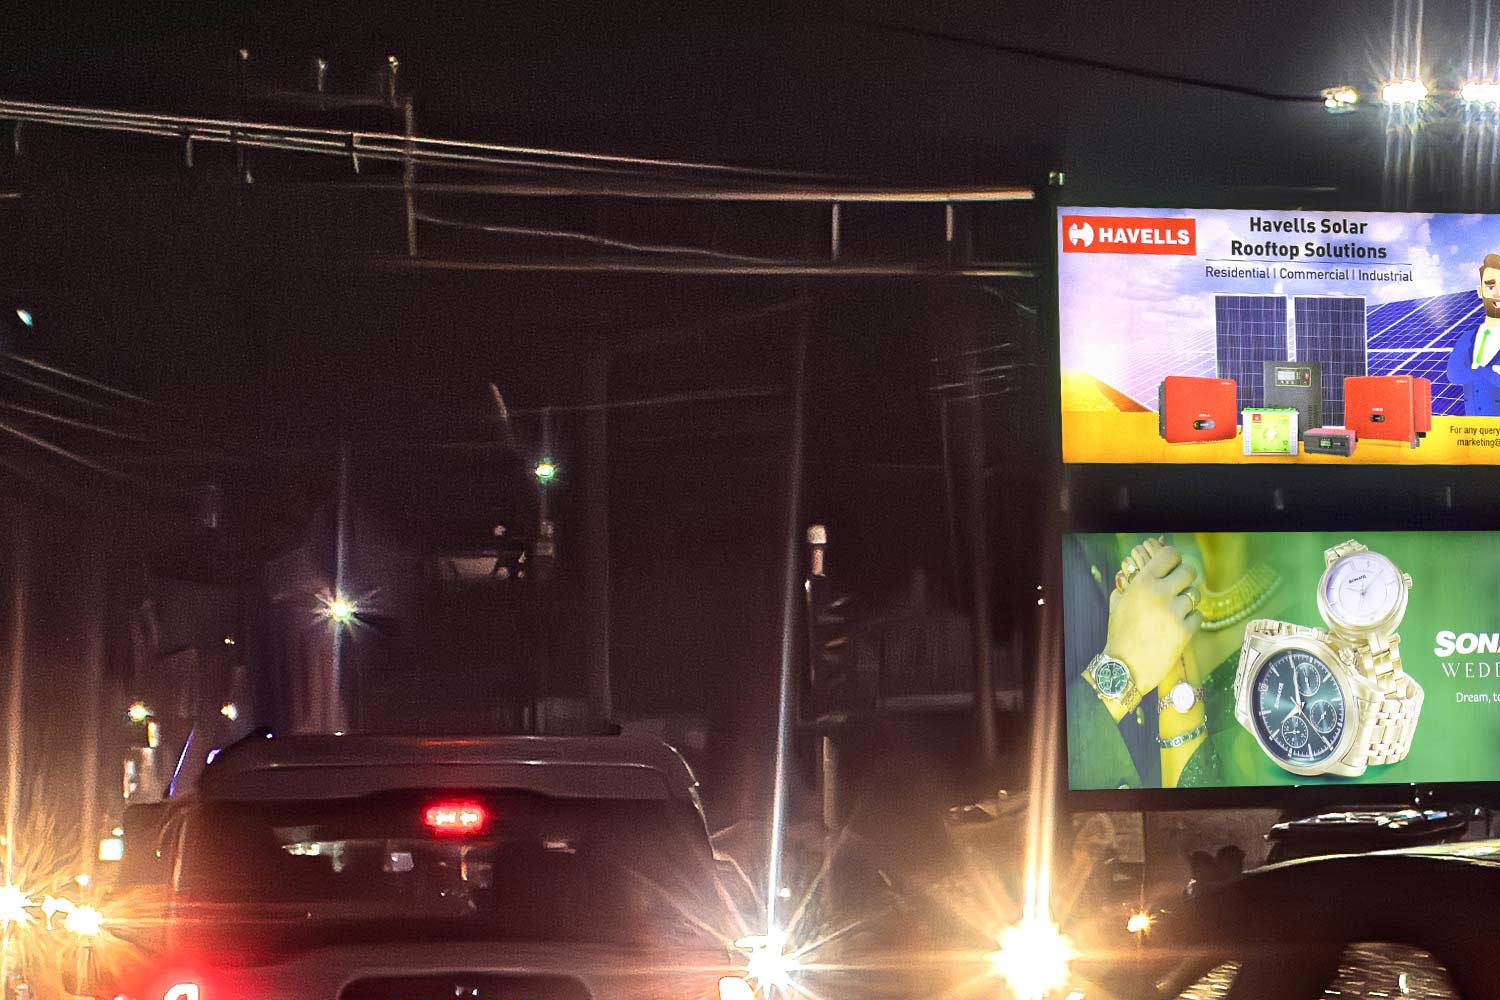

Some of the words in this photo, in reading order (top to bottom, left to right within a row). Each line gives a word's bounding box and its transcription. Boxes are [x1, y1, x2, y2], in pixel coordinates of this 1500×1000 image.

[1250, 217, 1316, 233] Havells
[1321, 219, 1367, 234] Solar
[1099, 228, 1190, 245] HAVELLS
[1231, 241, 1299, 259] Rooftop
[1305, 243, 1387, 258] Solutions
[1206, 266, 1270, 279] Residential
[1280, 268, 1348, 280] Commercial
[1359, 270, 1413, 282] Industrial
[1450, 426, 1460, 434] For
[1479, 428, 1500, 436] query
[1456, 692, 1491, 703] Dream,
